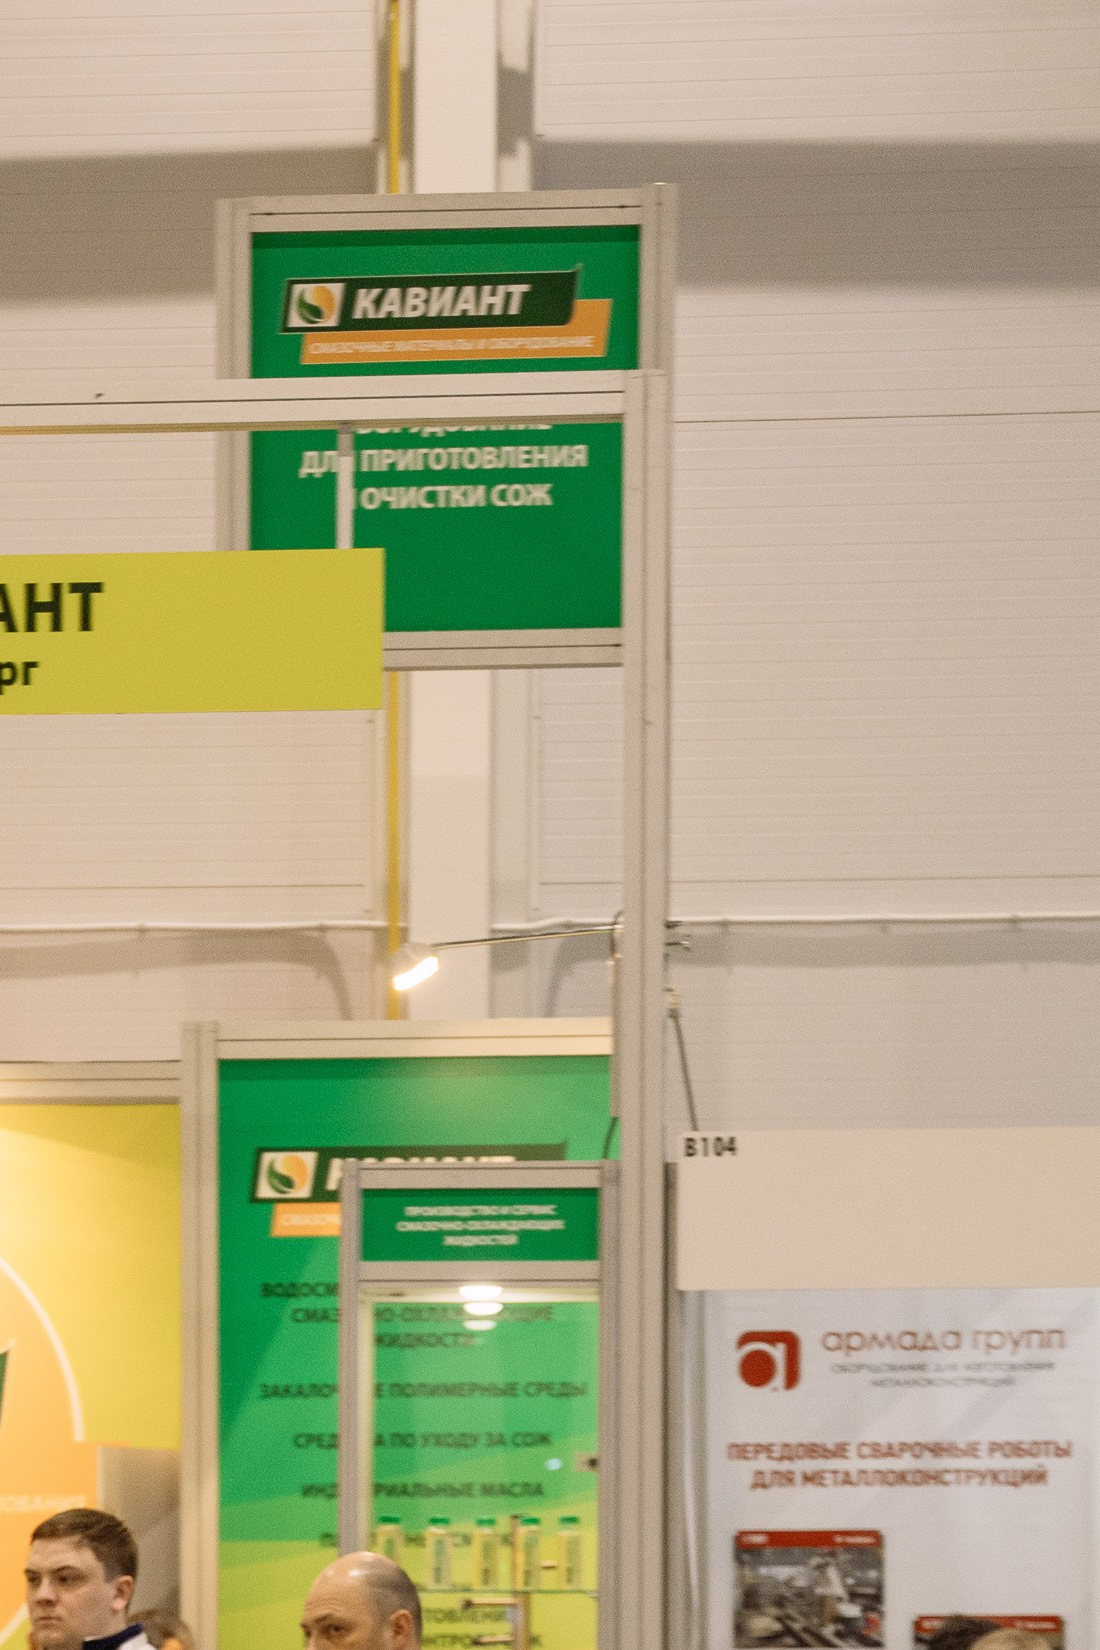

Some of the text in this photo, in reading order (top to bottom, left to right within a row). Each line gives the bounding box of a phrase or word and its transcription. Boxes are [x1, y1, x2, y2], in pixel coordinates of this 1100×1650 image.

[352, 283, 532, 320] КАВИАНТ
[298, 444, 589, 478] ДЛ ПРИГОТОВЛЕНИЯ
[360, 483, 553, 510] ОЧИСТКИ СОЖ
[821, 1328, 1067, 1357] армада групп
